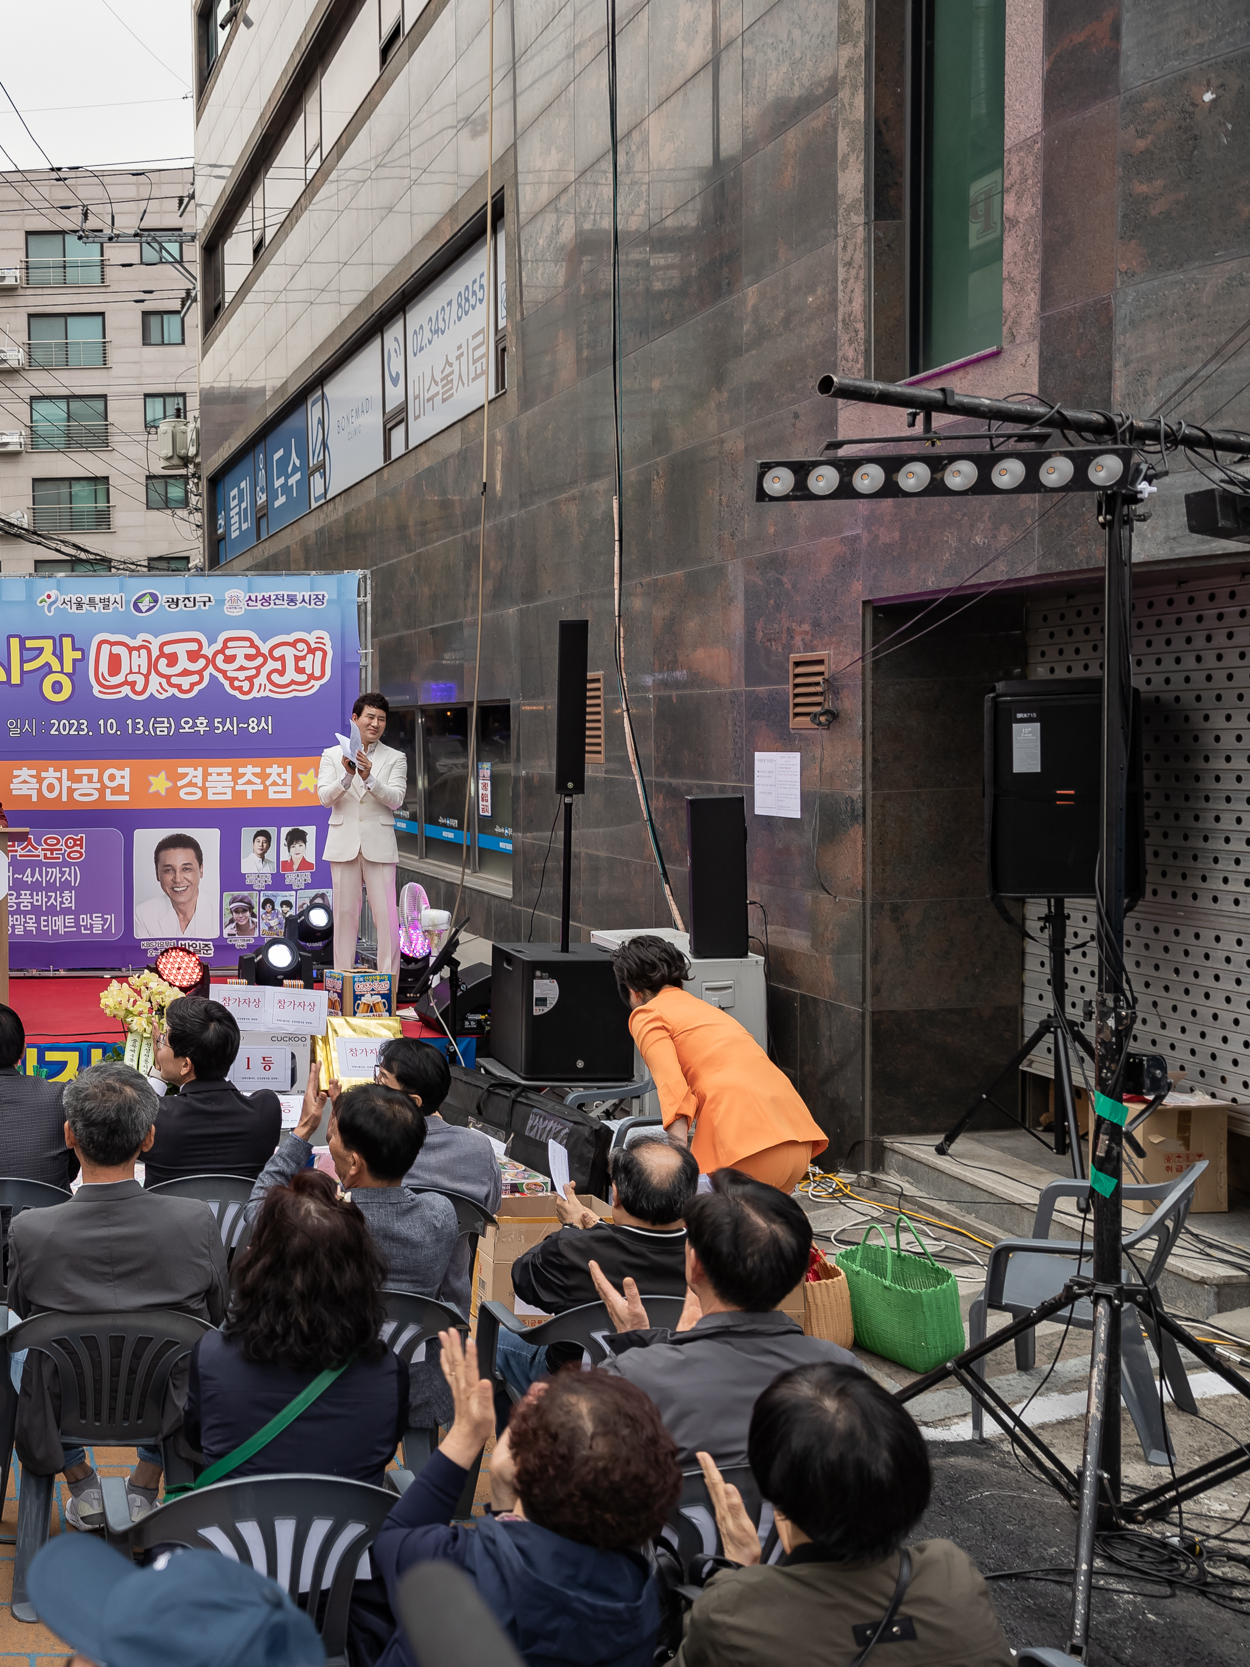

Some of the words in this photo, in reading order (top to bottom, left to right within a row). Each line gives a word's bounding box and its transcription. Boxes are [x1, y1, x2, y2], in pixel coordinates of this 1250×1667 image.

[412, 326, 486, 422] 비수술치료
[230, 476, 251, 540] 물리
[273, 437, 301, 509] 도수
[60, 594, 124, 611] 서울특별시
[164, 595, 213, 610] 광진구
[245, 593, 326, 608] 신성전통시장
[91, 632, 330, 699] 맥주축제
[7, 718, 37, 736] 일시
[49, 718, 93, 736] 2023.
[97, 718, 121, 736] 10.
[178, 716, 210, 735] 오후
[214, 714, 273, 735] 5시~8시
[10, 767, 131, 802] 축하공연
[176, 765, 293, 800] 경품추첨
[79, 913, 115, 934] 만들기
[222, 996, 262, 1009] 참가자상
[277, 998, 317, 1013] 참가자상
[270, 1035, 307, 1043] CUCKOO
[349, 1047, 380, 1058] 참가자
[260, 1056, 275, 1072] 등
